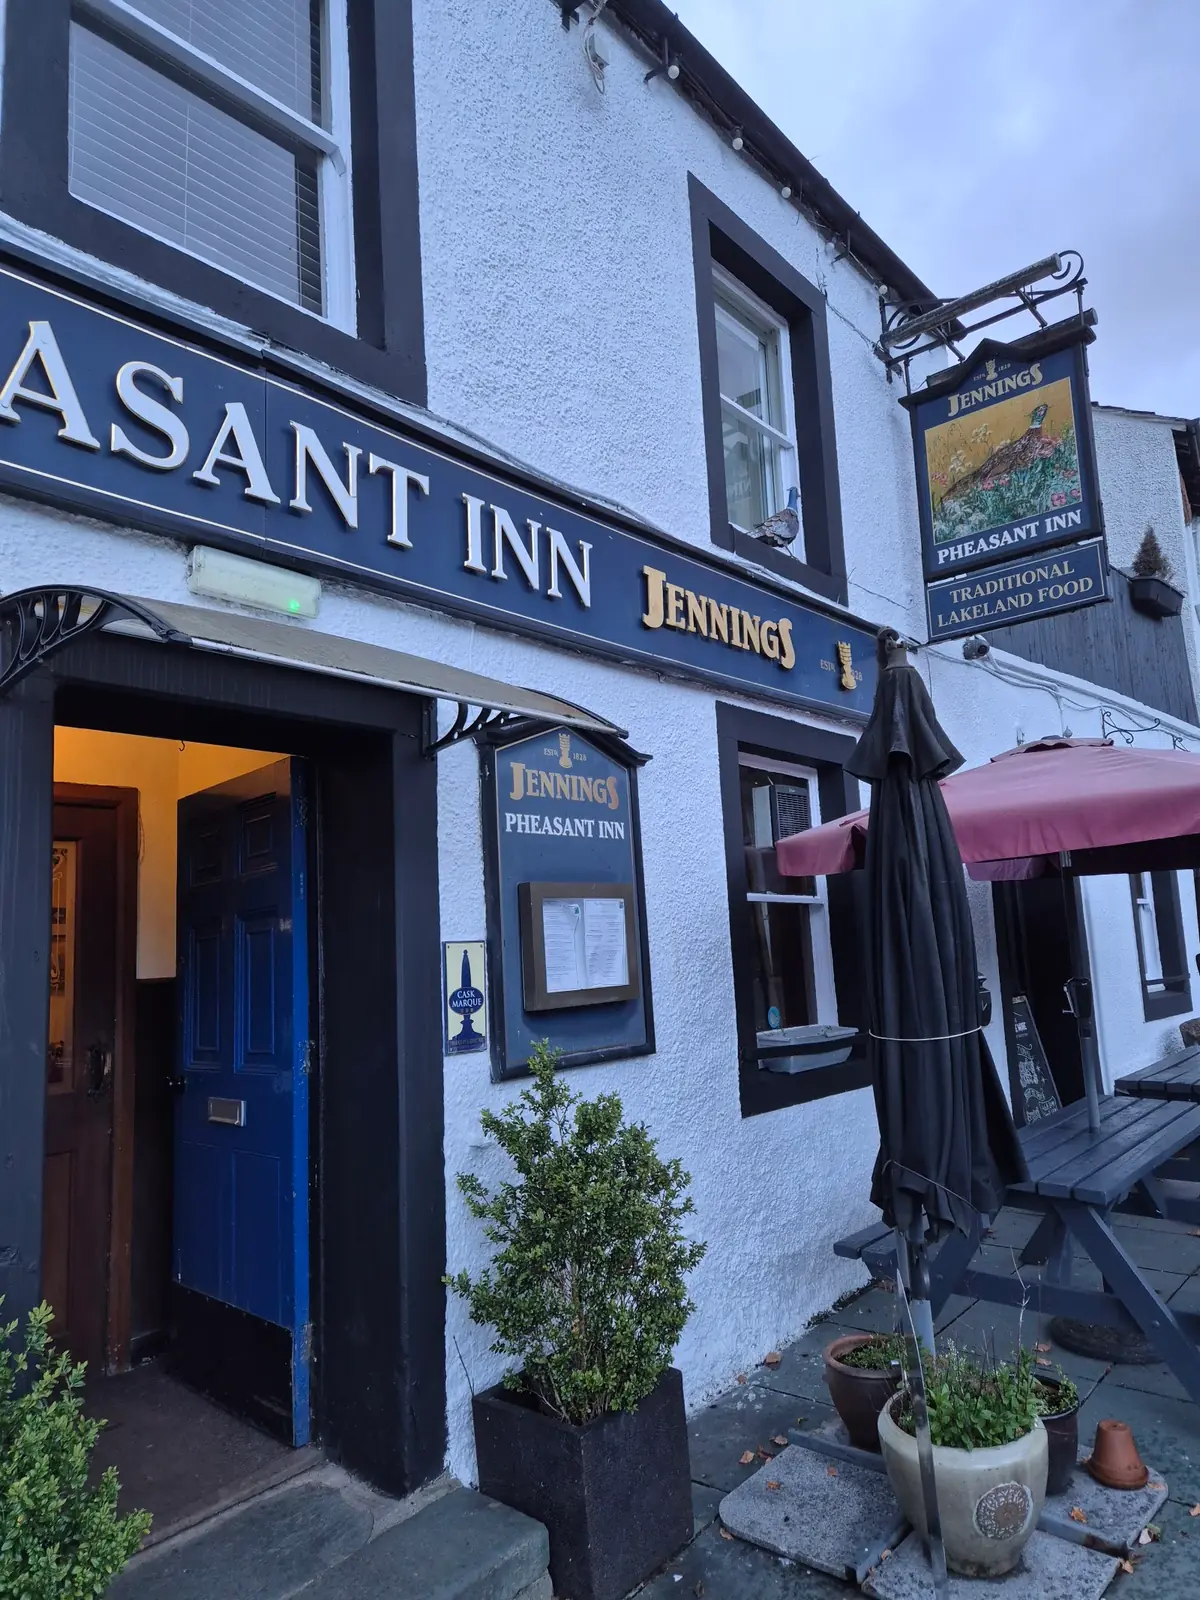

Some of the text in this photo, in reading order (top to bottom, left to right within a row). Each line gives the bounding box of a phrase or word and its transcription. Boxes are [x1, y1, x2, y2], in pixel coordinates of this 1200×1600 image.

[947, 362, 1043, 417] JENNINGS
[461, 491, 593, 607] INN
[937, 508, 1082, 564] PHEASANT INN
[938, 576, 1093, 628] LAKELAND FOOD
[950, 560, 1075, 604] TRADITIONAL
[642, 565, 796, 669] JENNINGS
[573, 752, 587, 761] 1828
[509, 762, 619, 810] JENNINGS
[505, 812, 625, 840] PHEASANT INN
[452, 998, 482, 1008] MARQUE
[457, 990, 475, 999] CASK
